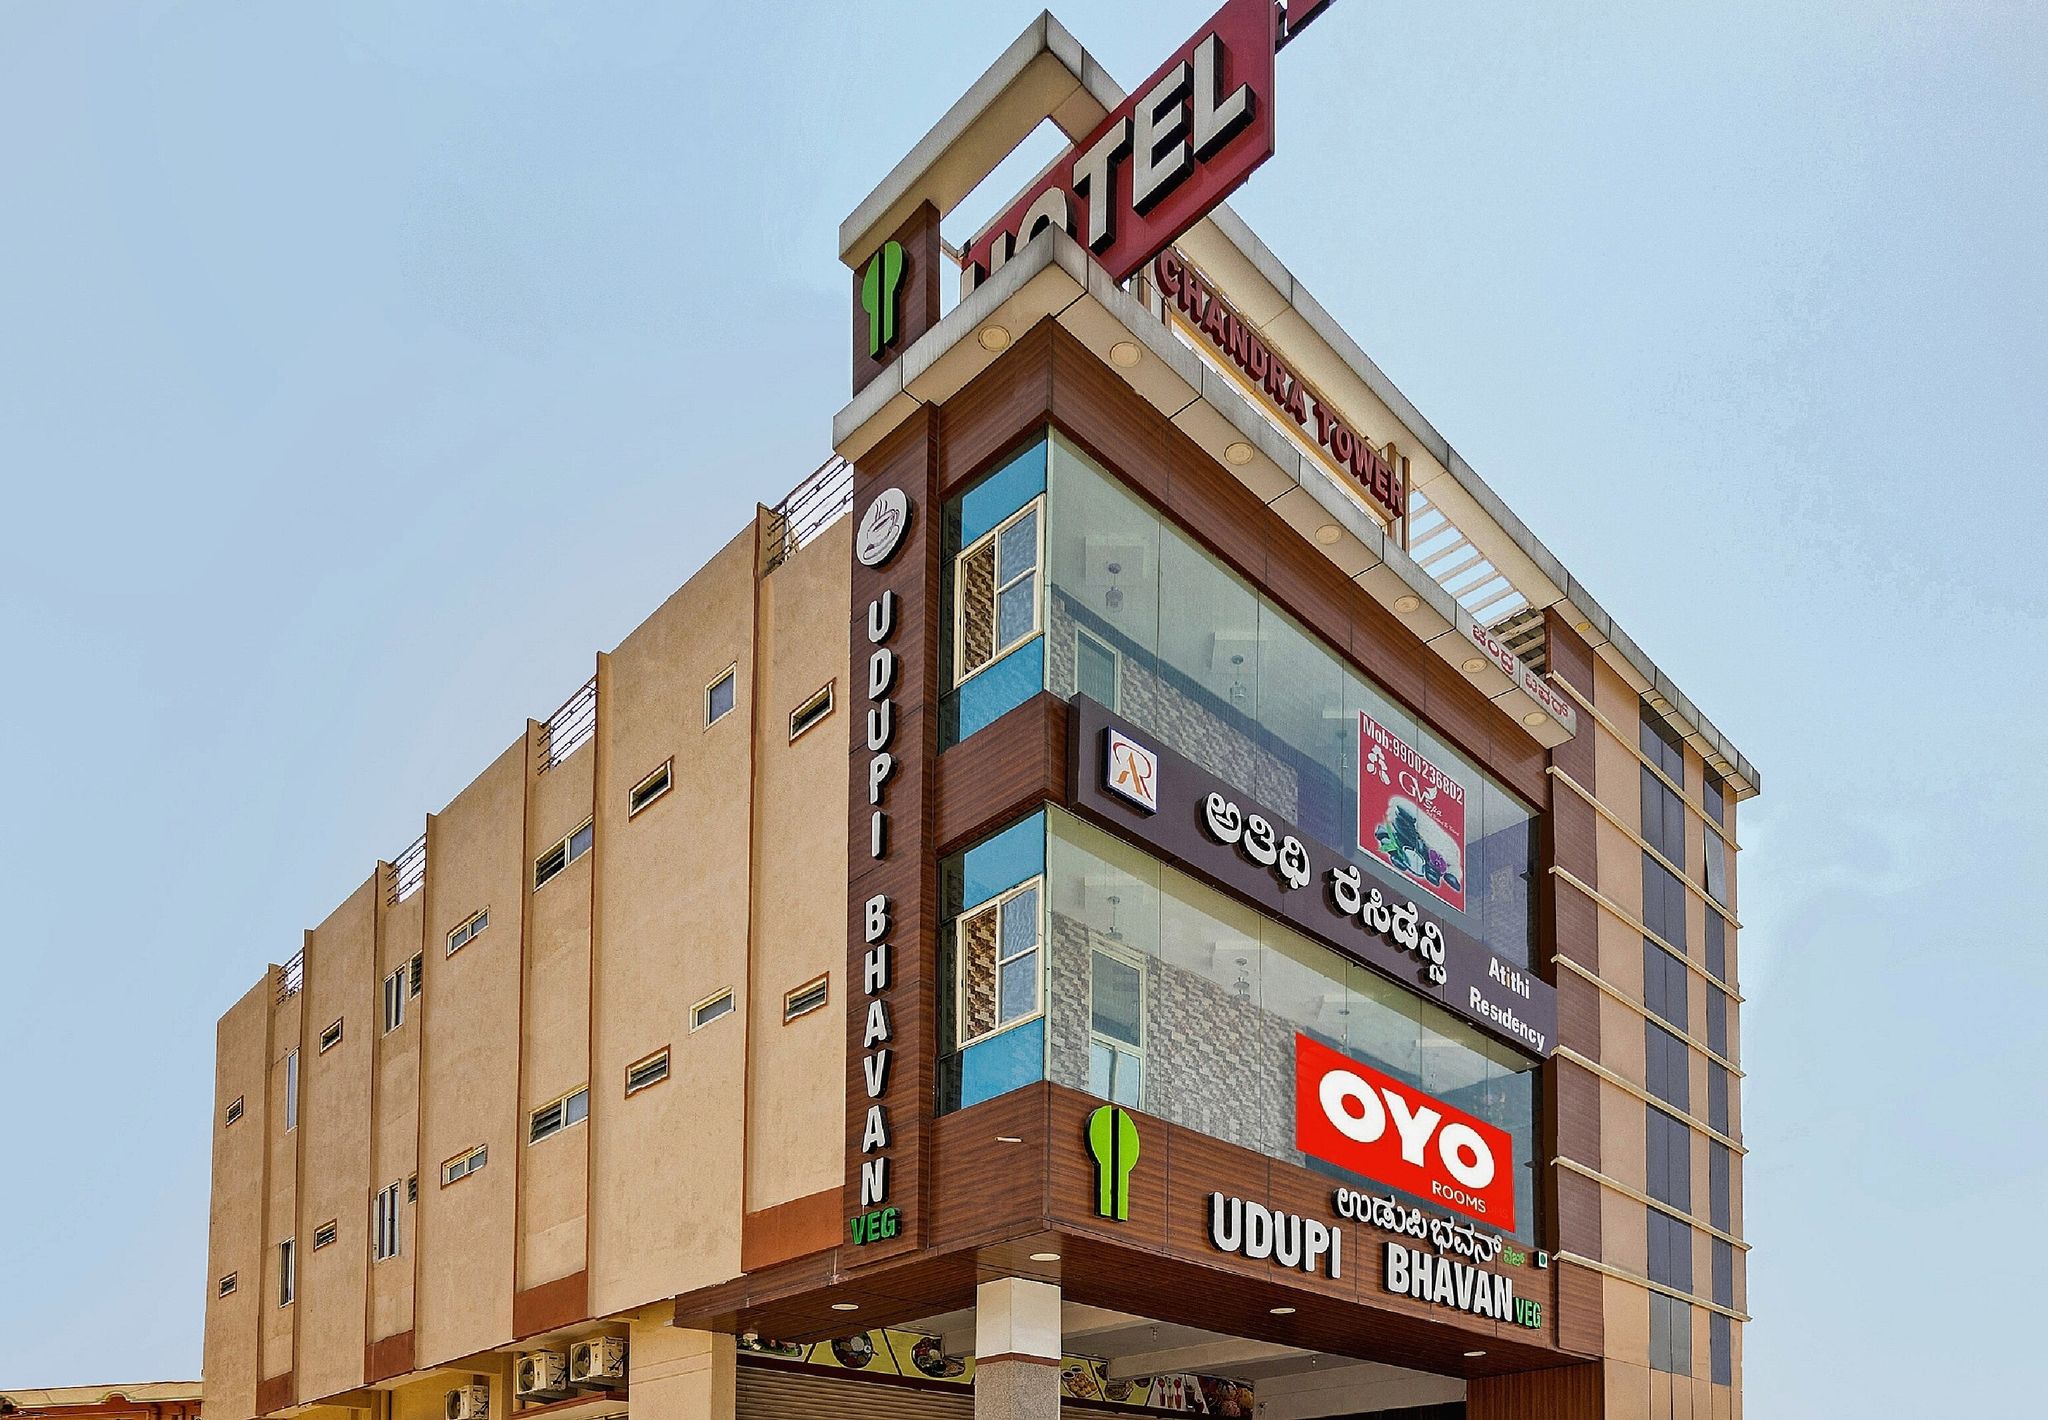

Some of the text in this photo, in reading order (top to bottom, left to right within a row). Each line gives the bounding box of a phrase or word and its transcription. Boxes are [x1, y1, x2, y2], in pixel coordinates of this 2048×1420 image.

[1155, 247, 1404, 518] CHANDRA TOWER
[1363, 714, 1464, 805] Mob:9900236802
[850, 589, 897, 1245] UDUPI BHAVAN VEG
[1206, 792, 1447, 985] ಅತಿಥಿ ರೆಸಿಡೆನ್ಸಿ
[1469, 986, 1545, 1052] Residency
[1489, 957, 1530, 999] Atithi
[1319, 1069, 1495, 1188] OYO
[1432, 1180, 1486, 1213] ROOMS
[1212, 1192, 1542, 1328] UDUPI BHAVAN VEG
